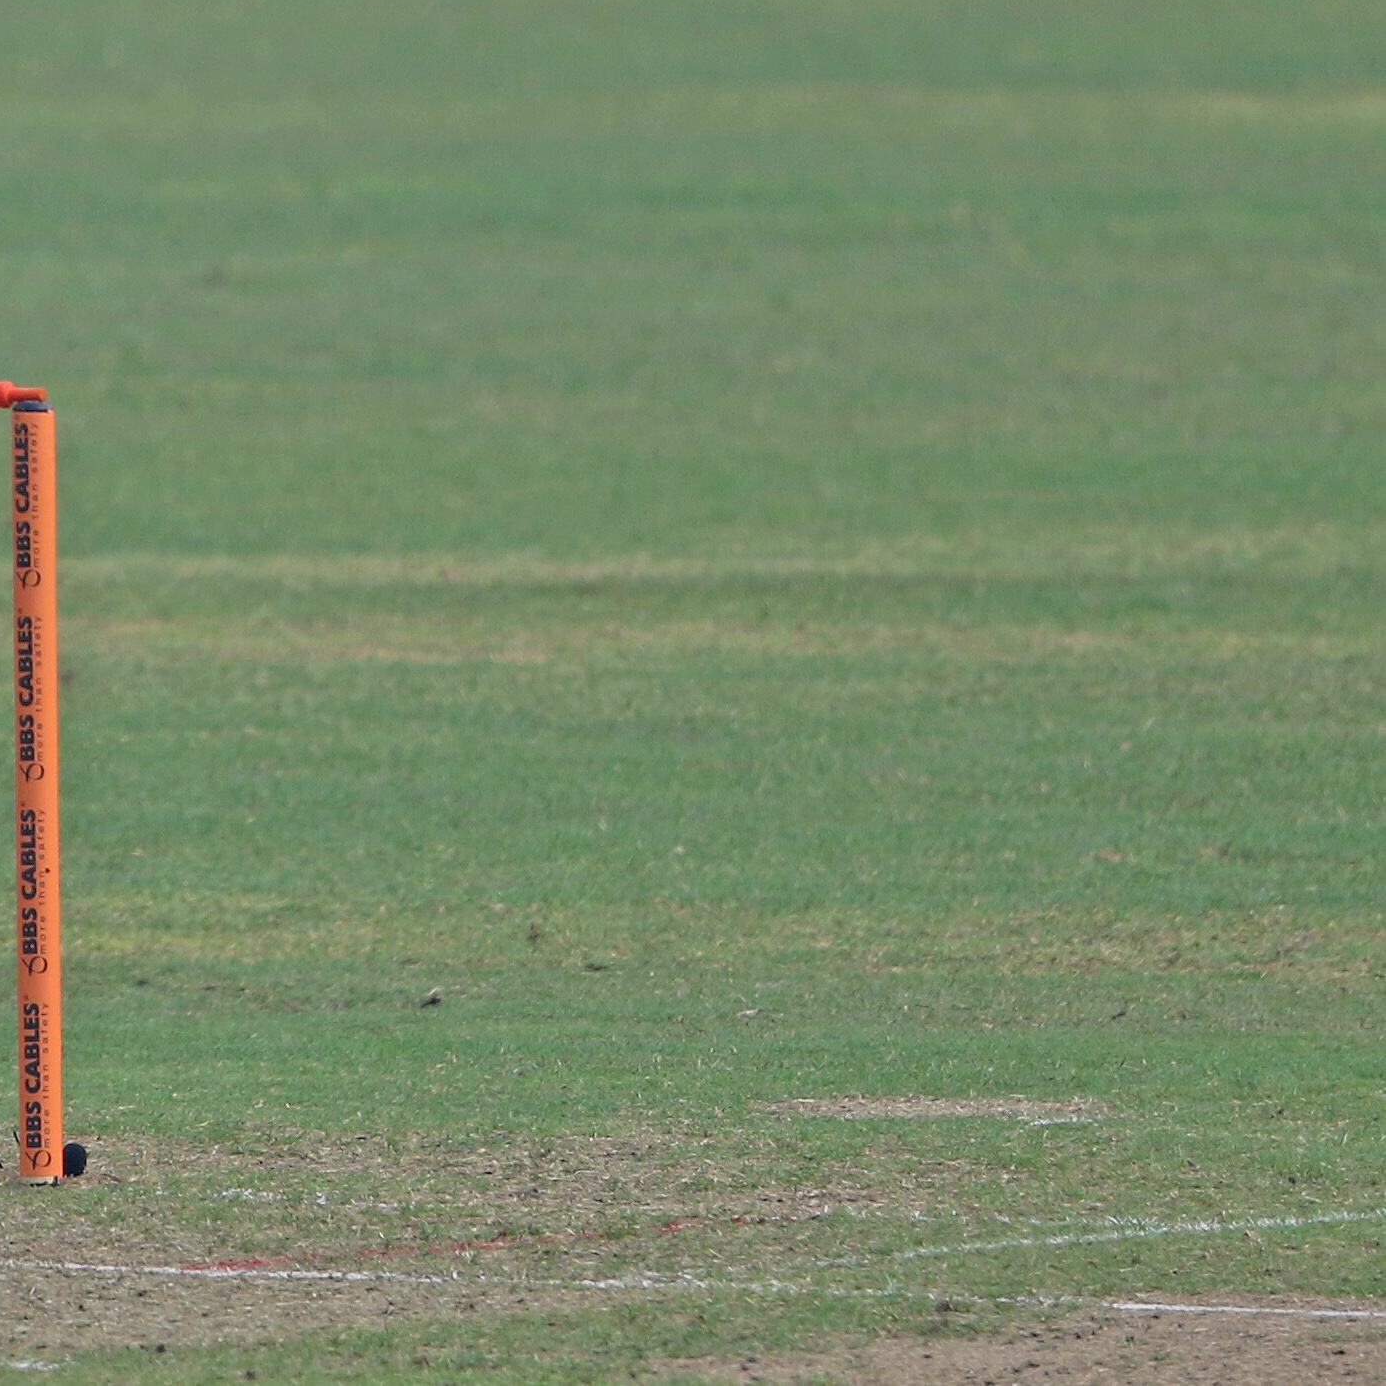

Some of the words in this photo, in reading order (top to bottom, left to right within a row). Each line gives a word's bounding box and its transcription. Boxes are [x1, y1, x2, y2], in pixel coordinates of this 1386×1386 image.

[14, 422, 30, 513] CABLES
[16, 521, 31, 568] BBS
[18, 616, 34, 706] CABLES
[19, 714, 35, 761] BBS
[20, 809, 36, 900] CABLES
[22, 907, 37, 954] BBS
[24, 1002, 40, 1094] CABLES
[25, 1101, 42, 1148] BBS
